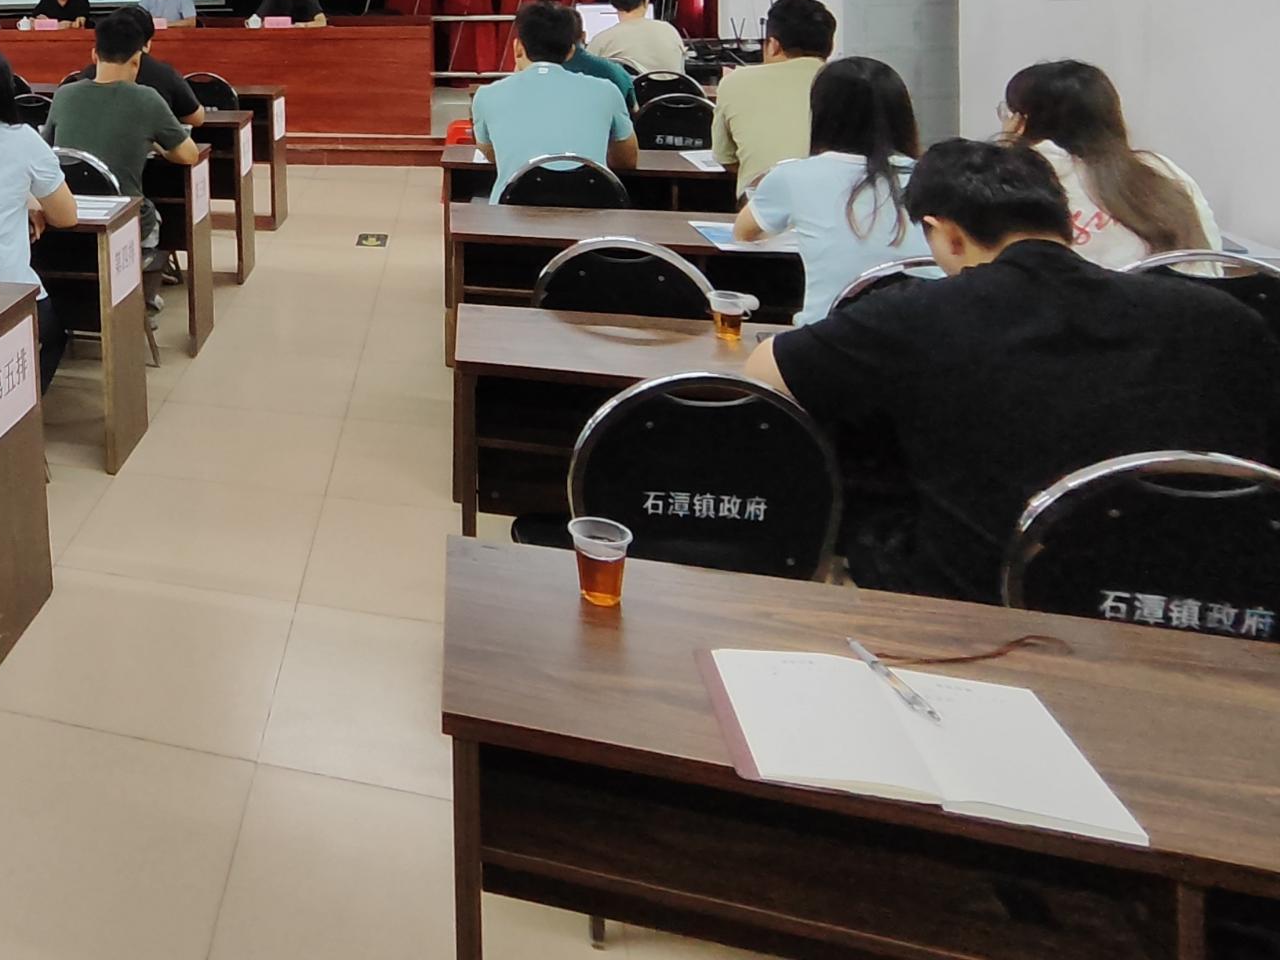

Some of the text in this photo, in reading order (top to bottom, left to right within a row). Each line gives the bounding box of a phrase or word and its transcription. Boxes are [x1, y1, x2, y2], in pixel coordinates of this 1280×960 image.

[643, 491, 768, 521] 石潭镇政府
[1098, 589, 1276, 638] 石潭镇政府
